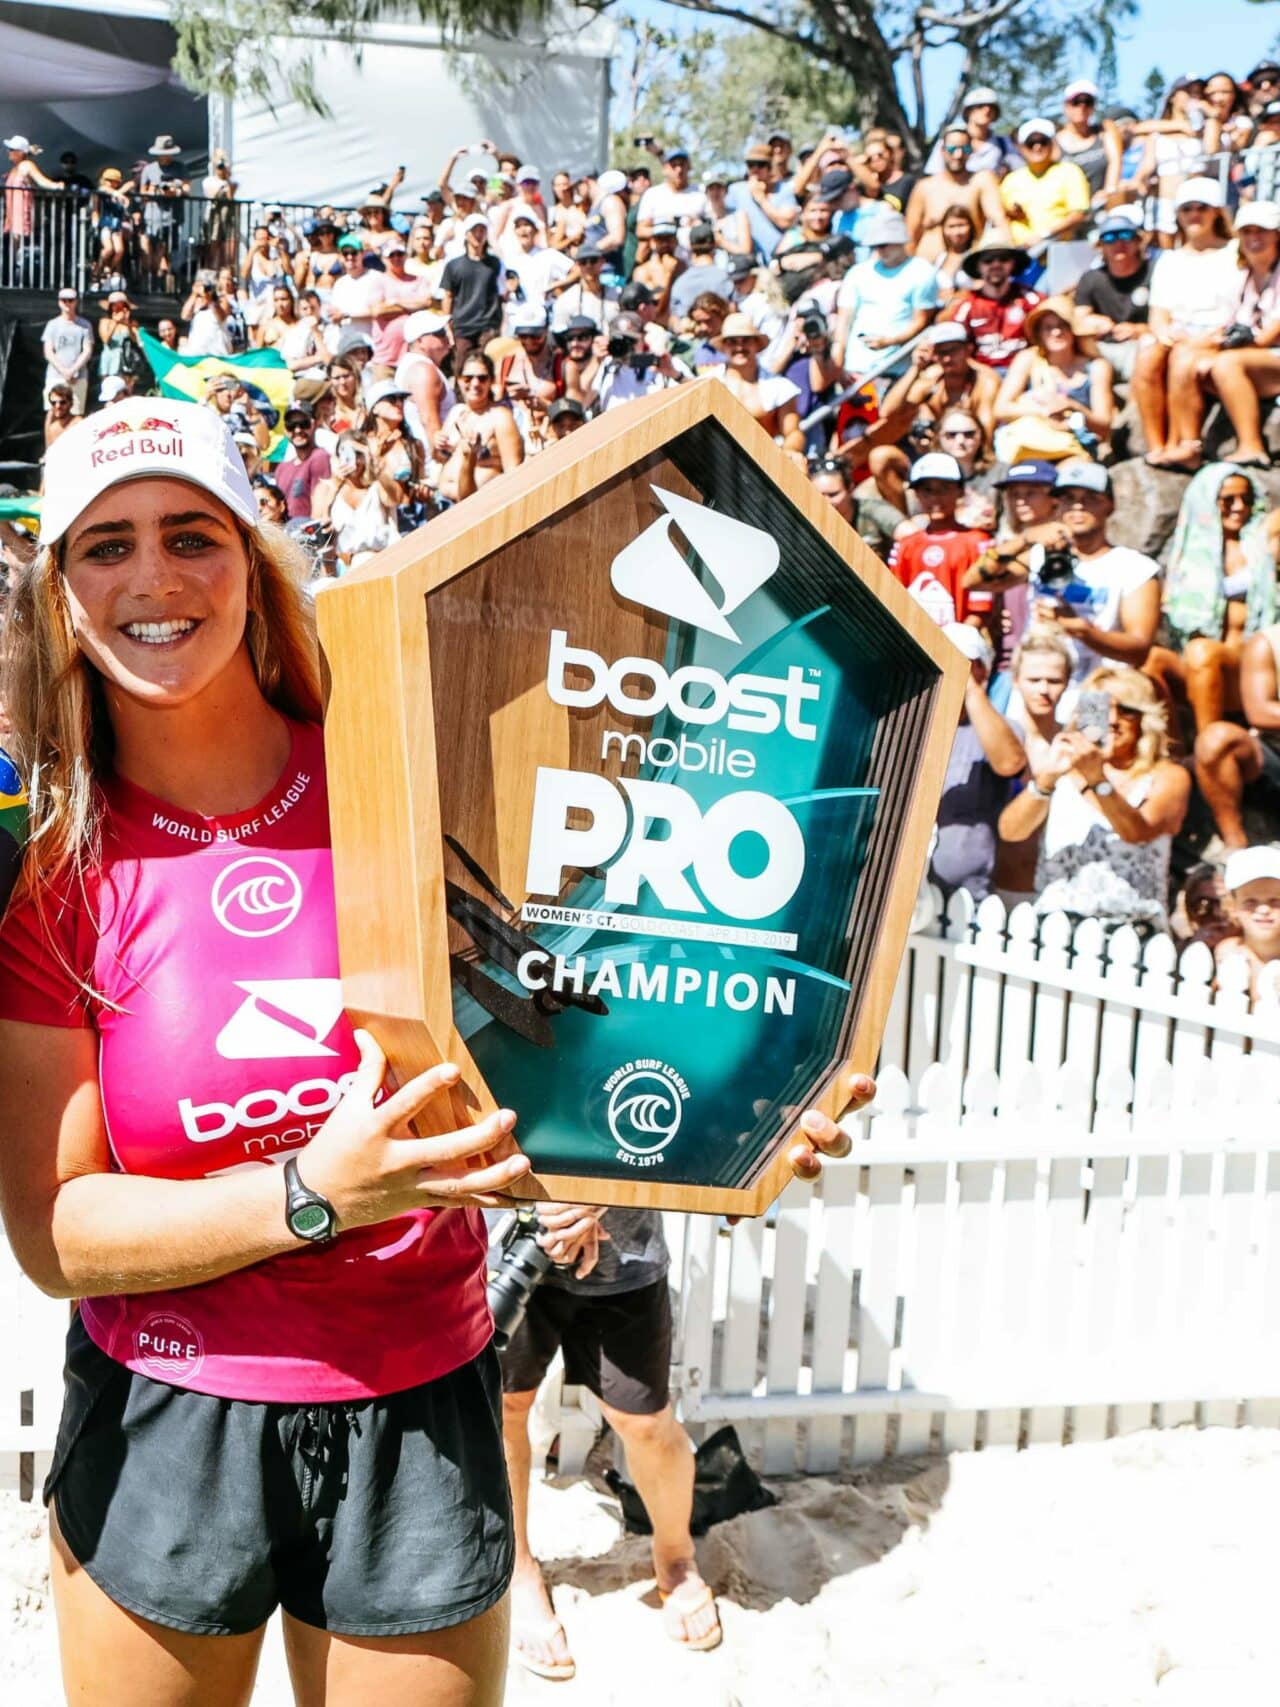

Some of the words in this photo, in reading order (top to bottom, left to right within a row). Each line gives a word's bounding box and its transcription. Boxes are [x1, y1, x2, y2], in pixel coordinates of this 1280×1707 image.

[90, 440, 134, 468] Red
[140, 438, 184, 458] Bull
[546, 629, 821, 742] boost
[601, 729, 757, 779] mobile
[152, 813, 212, 844] WORLD
[216, 819, 262, 843] SURF
[264, 771, 311, 826] LEAGUE
[525, 766, 806, 921] PRO
[525, 906, 593, 926] WOMEN'S
[516, 950, 798, 1017] CHAMPION
[602, 1062, 635, 1092] WORLD
[635, 1059, 663, 1071] SURF
[662, 1064, 692, 1100] LEAGUE
[616, 1149, 636, 1166] EST.
